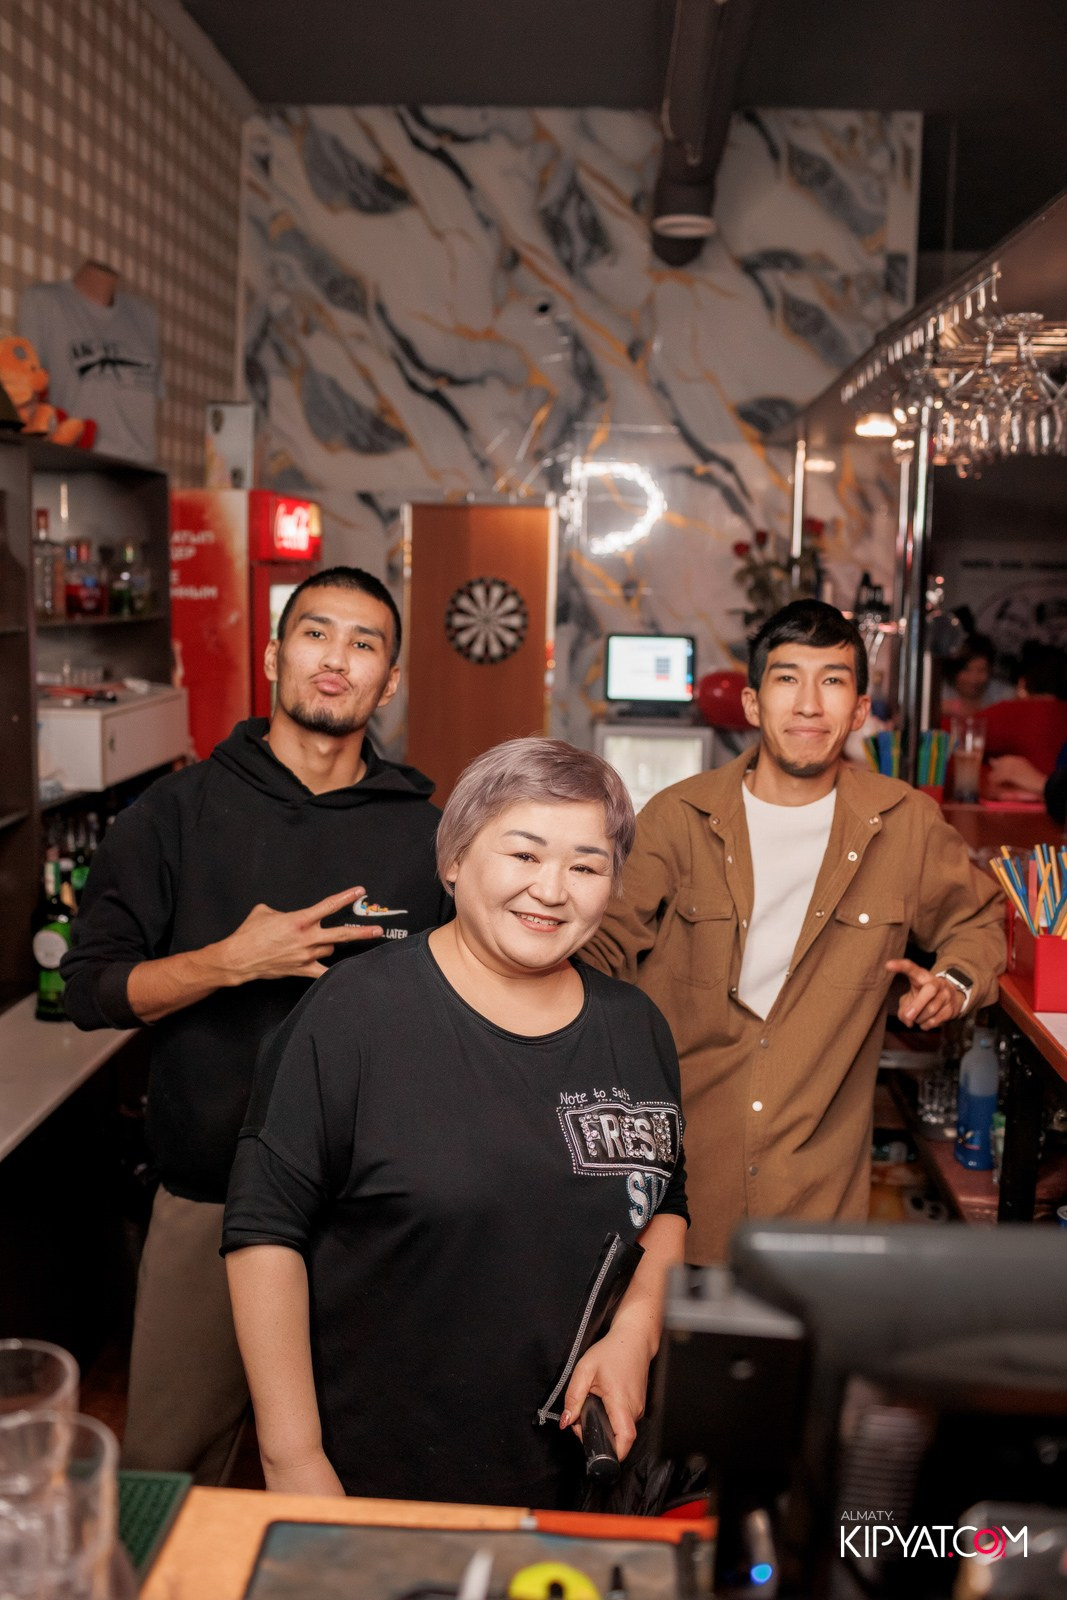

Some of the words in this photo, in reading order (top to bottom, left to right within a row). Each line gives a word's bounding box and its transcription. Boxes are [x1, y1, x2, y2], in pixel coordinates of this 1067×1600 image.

[386, 928, 408, 939] LATER
[560, 1092, 588, 1105] Note
[593, 1088, 606, 1099] to
